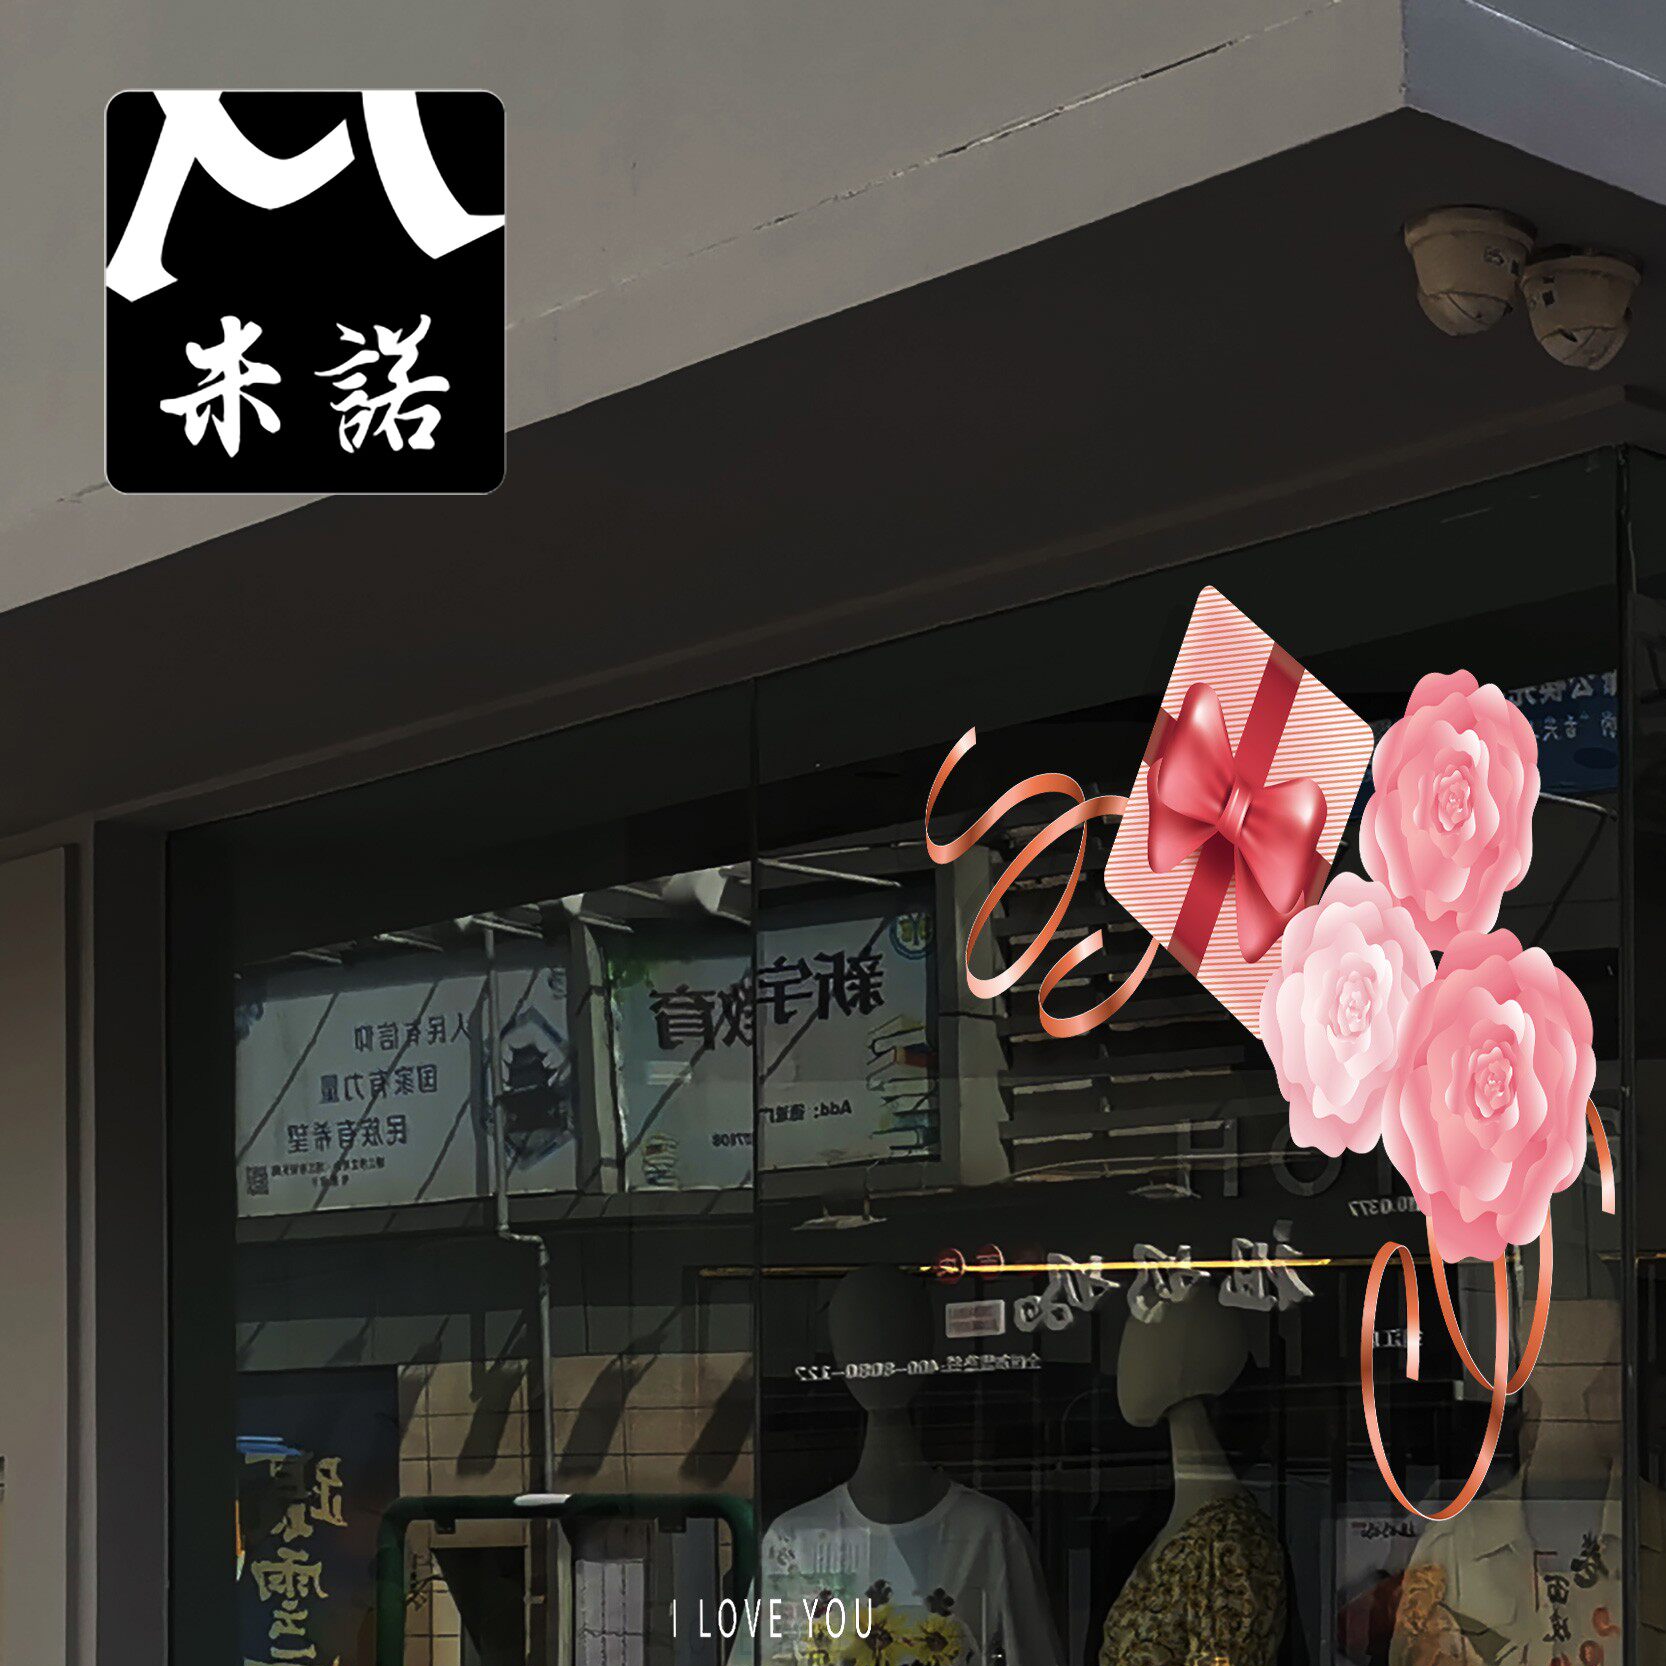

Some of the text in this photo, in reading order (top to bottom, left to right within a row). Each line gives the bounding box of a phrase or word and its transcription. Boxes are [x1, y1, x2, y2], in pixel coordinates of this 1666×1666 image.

[672, 1597, 873, 1640] I LOVE YOU
